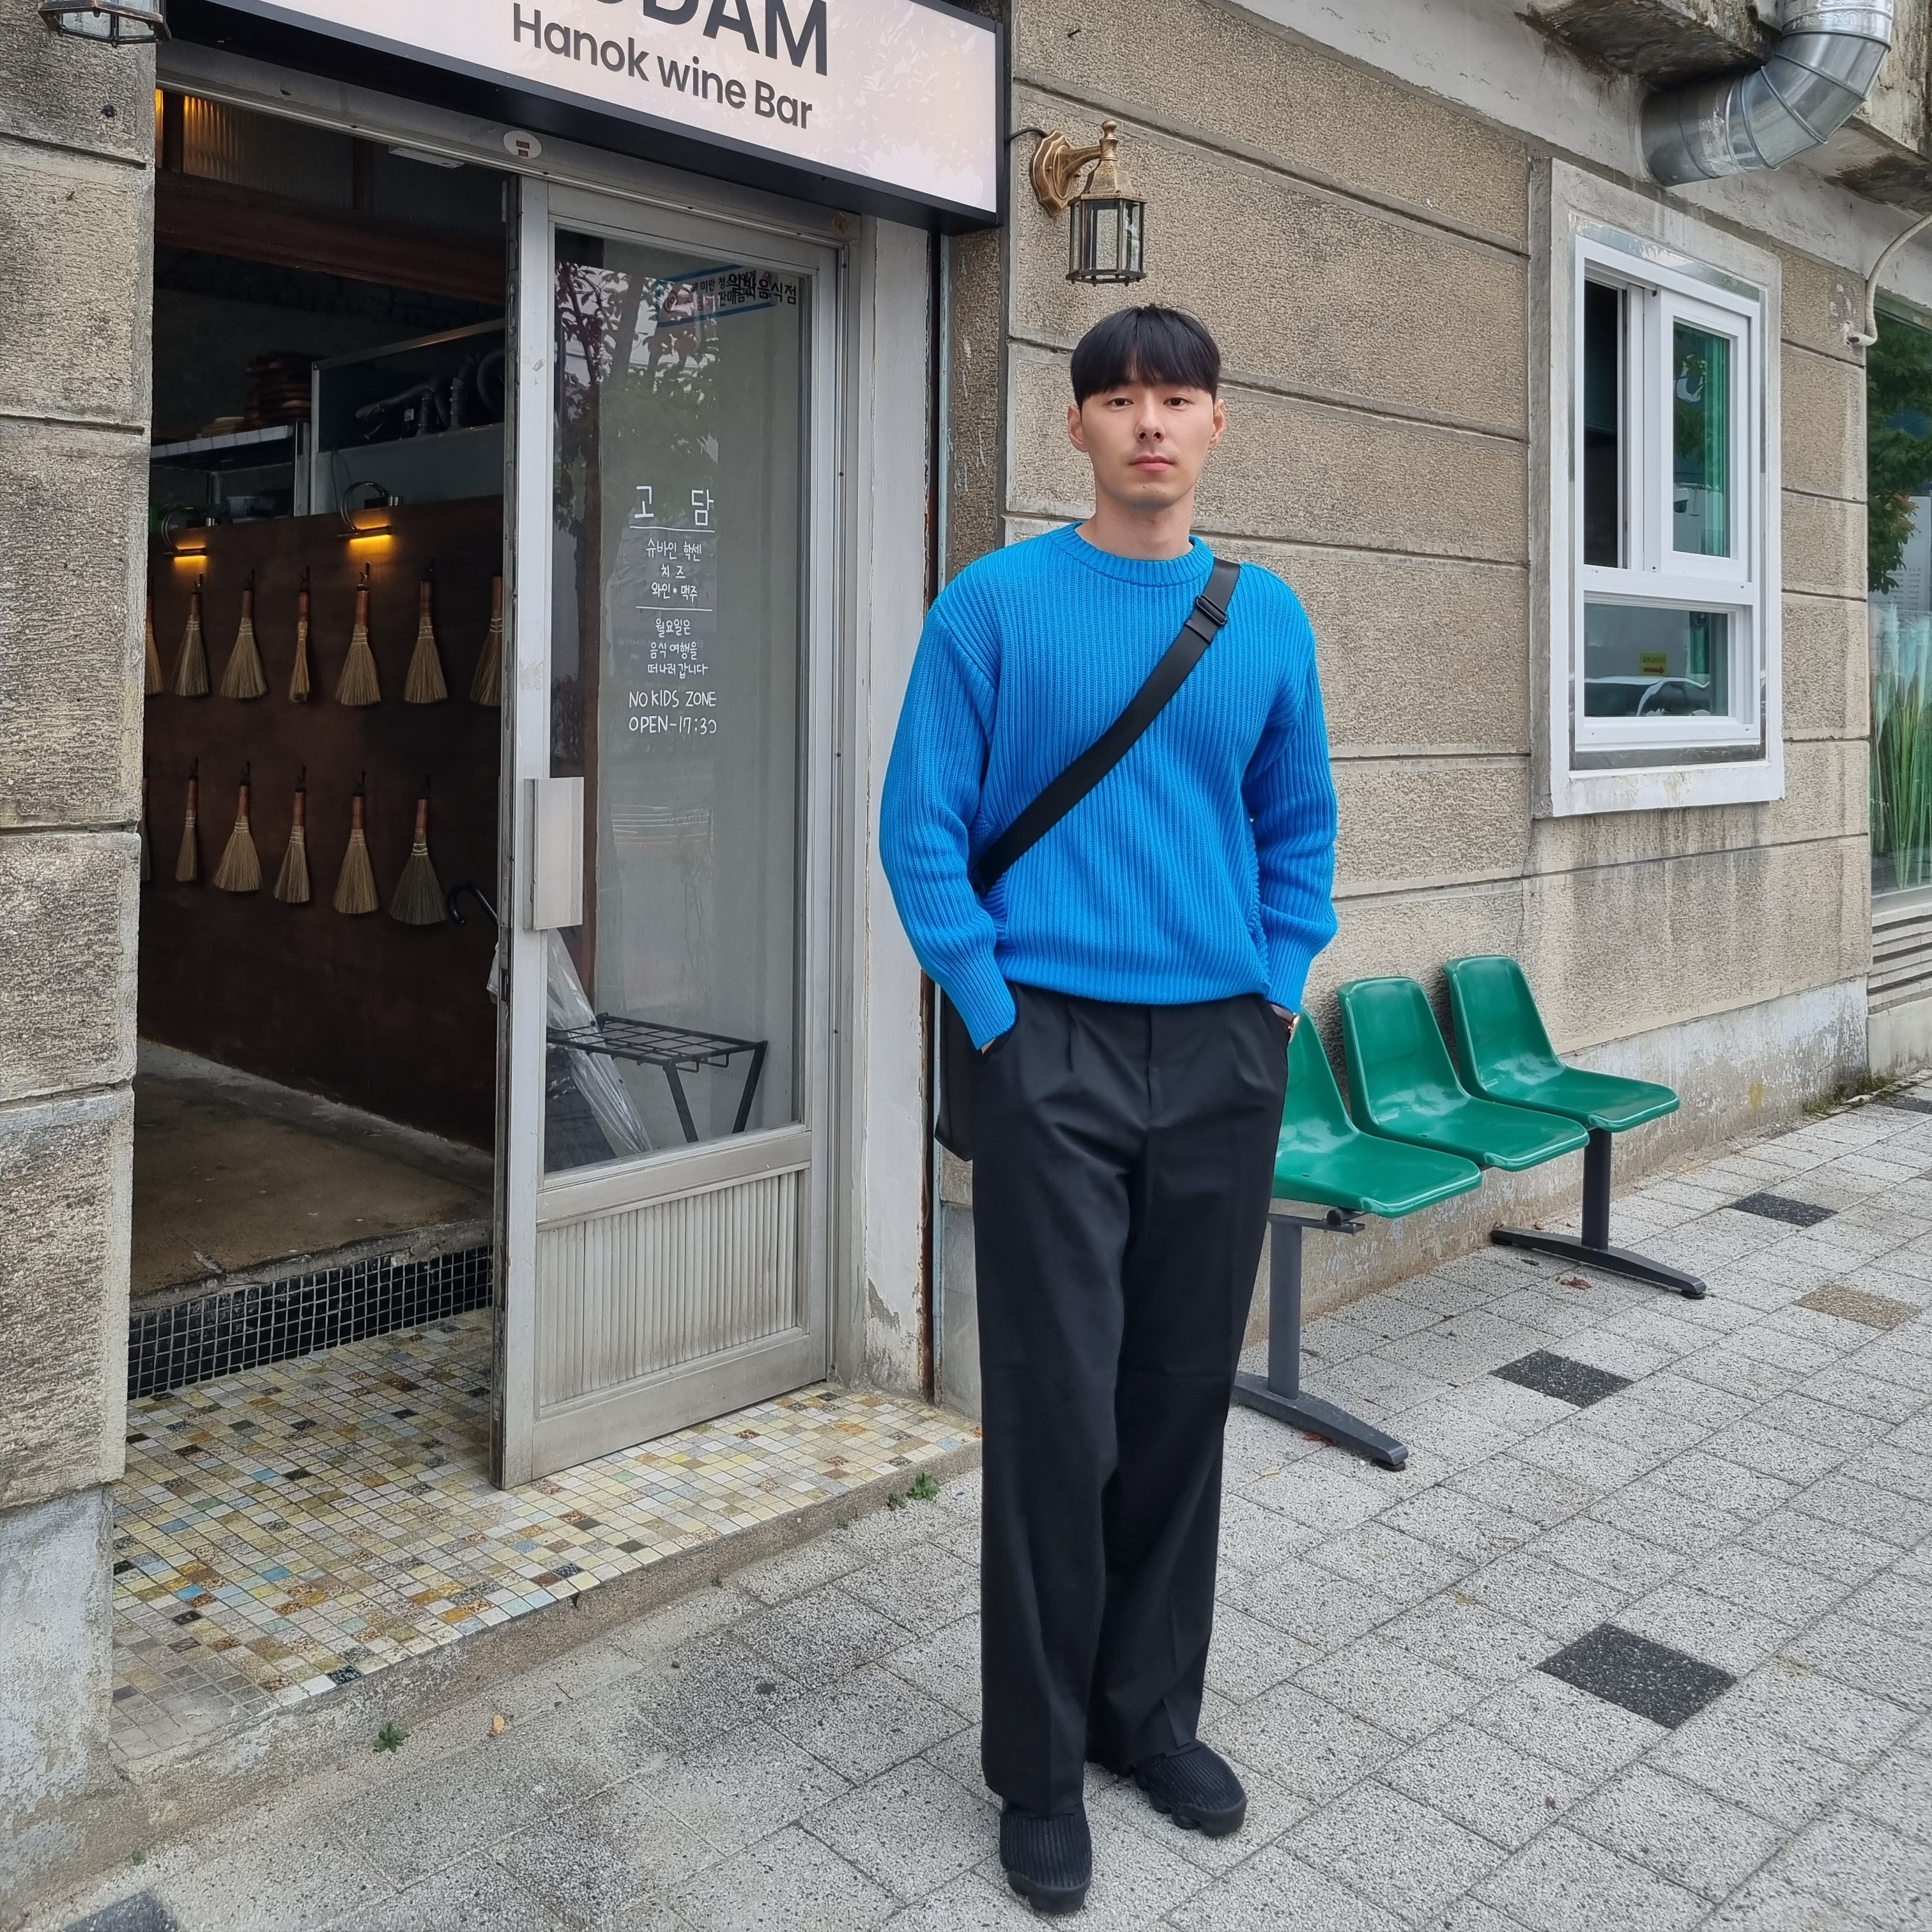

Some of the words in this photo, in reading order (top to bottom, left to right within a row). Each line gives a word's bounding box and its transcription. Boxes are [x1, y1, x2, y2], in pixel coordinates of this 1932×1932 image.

[594, 0, 828, 76] AM
[513, 3, 650, 82] Hanok
[657, 56, 747, 109] wine
[755, 79, 813, 130] Bar
[645, 537, 677, 560] 슈바인
[683, 541, 702, 562] 학센
[655, 618, 691, 638] 월요일은
[650, 641, 667, 659] 음식
[669, 641, 698, 661] 여행을
[629, 691, 648, 708] NO
[651, 689, 679, 707] KIDS
[685, 691, 717, 707] ZONE
